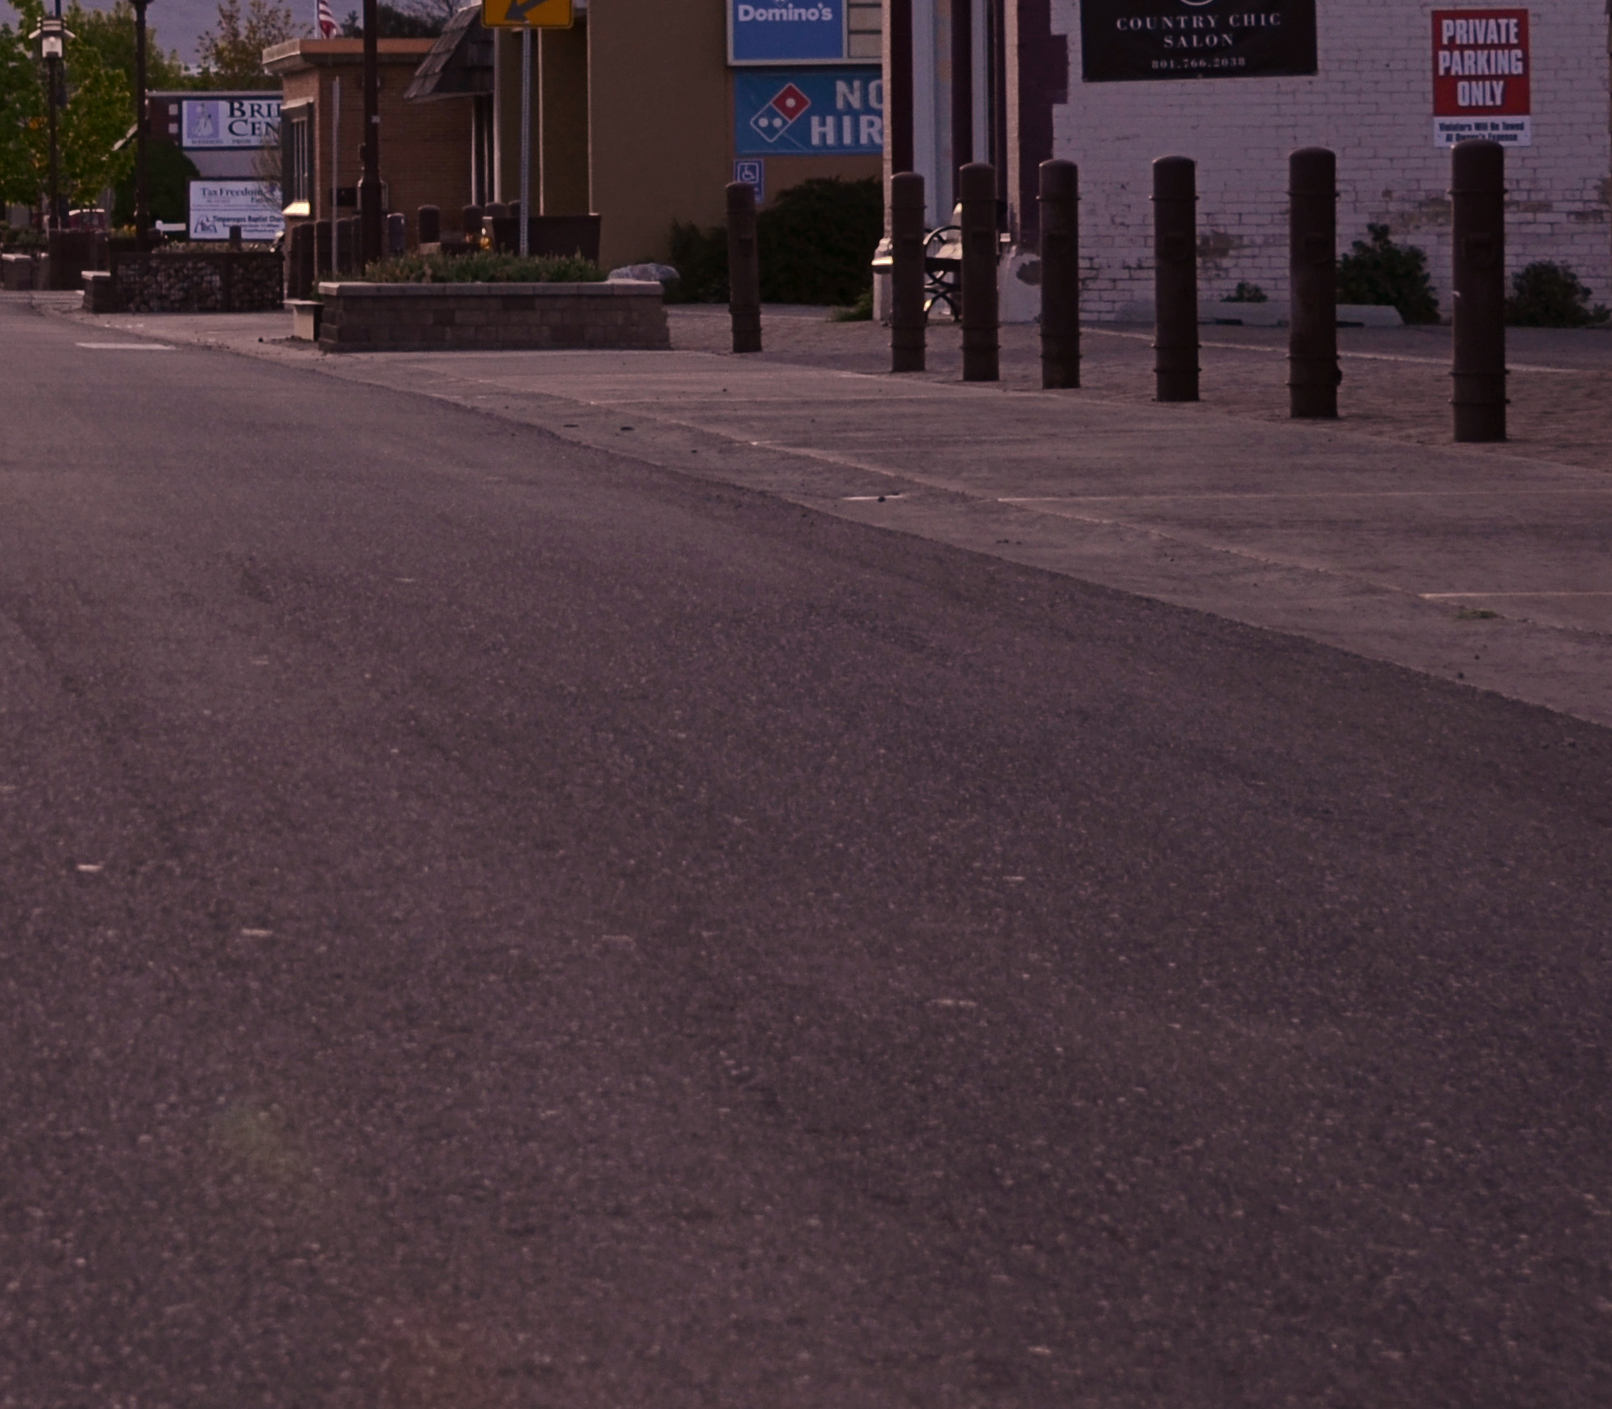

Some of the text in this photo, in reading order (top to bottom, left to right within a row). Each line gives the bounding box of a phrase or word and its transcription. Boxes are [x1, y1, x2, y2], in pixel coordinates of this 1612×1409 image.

[738, 3, 833, 22] Domino's
[1116, 13, 1282, 31] COUNTRY CHIC
[1164, 34, 1234, 49] SALON
[1441, 18, 1519, 45] PRIVATE
[1438, 49, 1523, 76] PARKING
[836, 80, 883, 110] NO
[1457, 80, 1504, 107] ONLY
[228, 119, 281, 137] CEN
[811, 115, 883, 145] HIR
